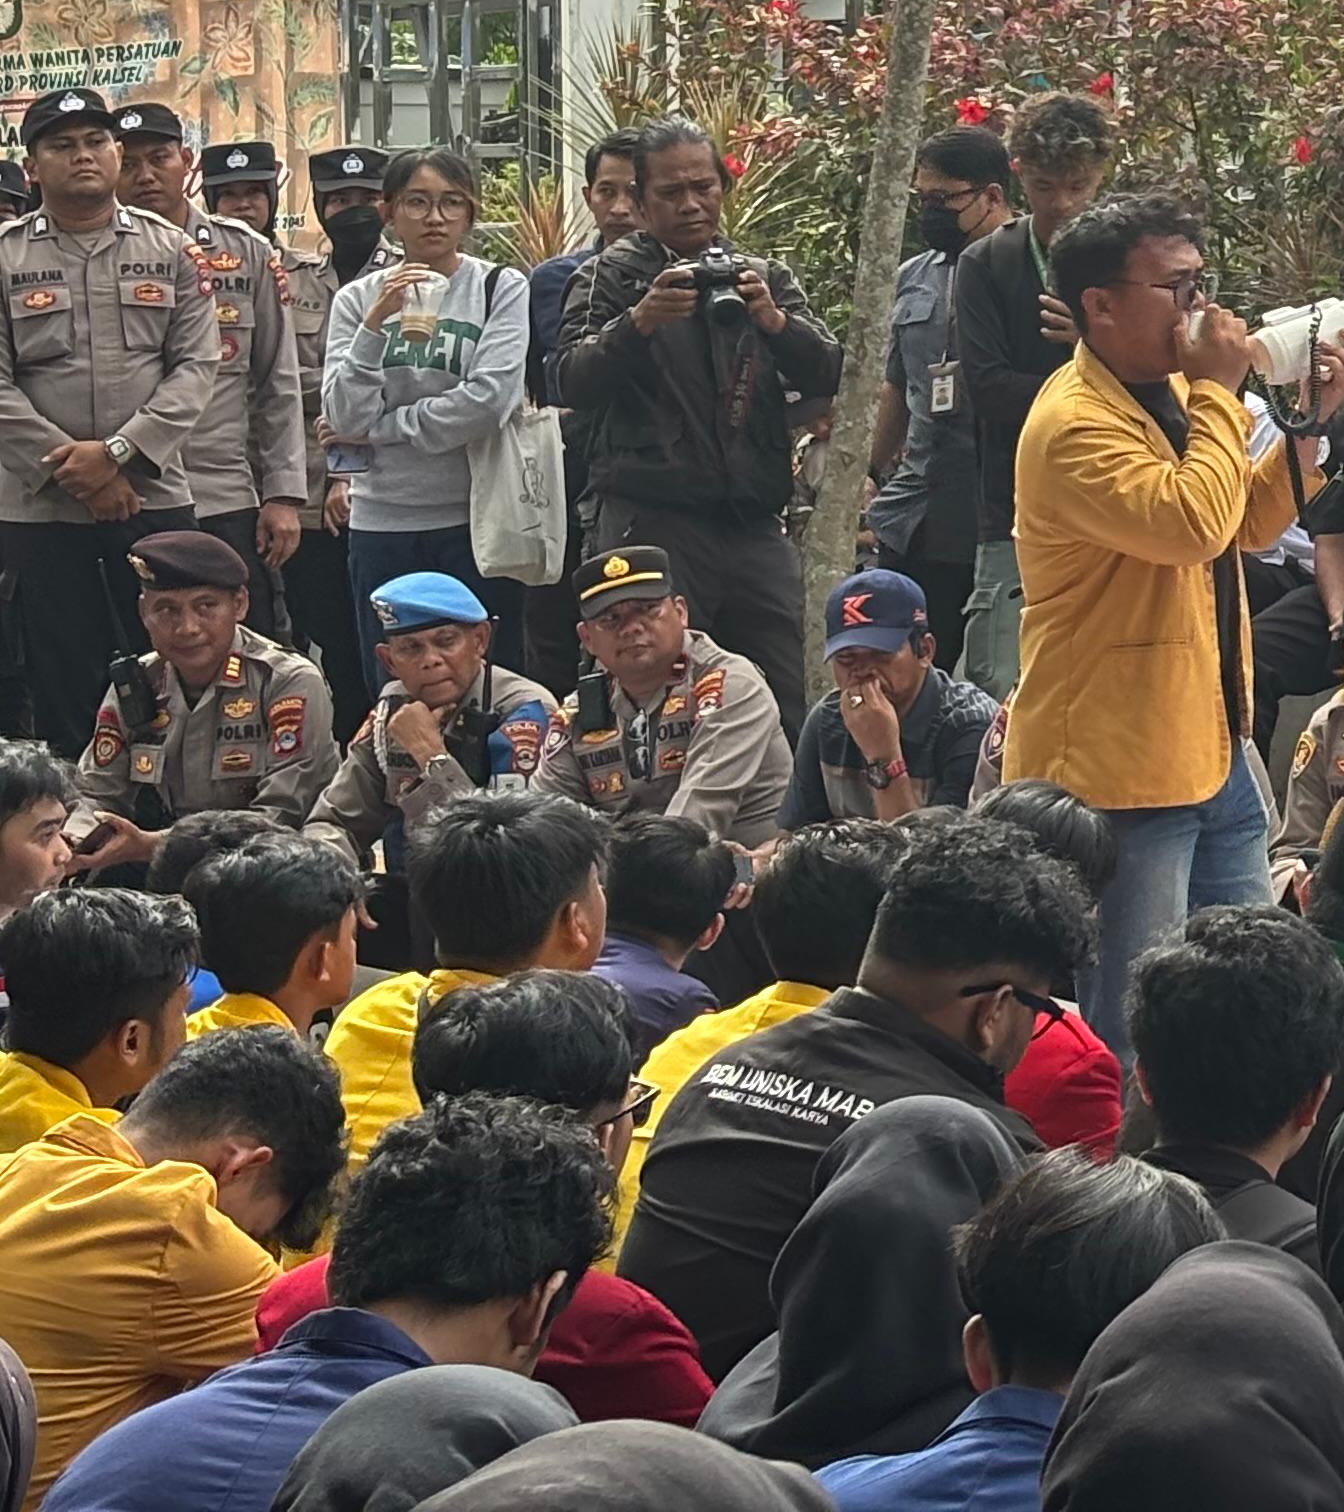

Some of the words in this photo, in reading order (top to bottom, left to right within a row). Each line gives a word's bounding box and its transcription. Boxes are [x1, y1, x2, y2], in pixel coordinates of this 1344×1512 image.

[29, 48, 92, 68] WANITA
[94, 40, 183, 64] PERSATUAN
[19, 69, 87, 92] PROVINSI
[91, 65, 143, 87] KALSEL
[120, 262, 172, 276] POLRI
[211, 276, 251, 291] OLRI
[700, 1063, 746, 1087] BEM
[739, 1065, 815, 1106] UNISKA
[790, 1105, 830, 1126] KARYA
